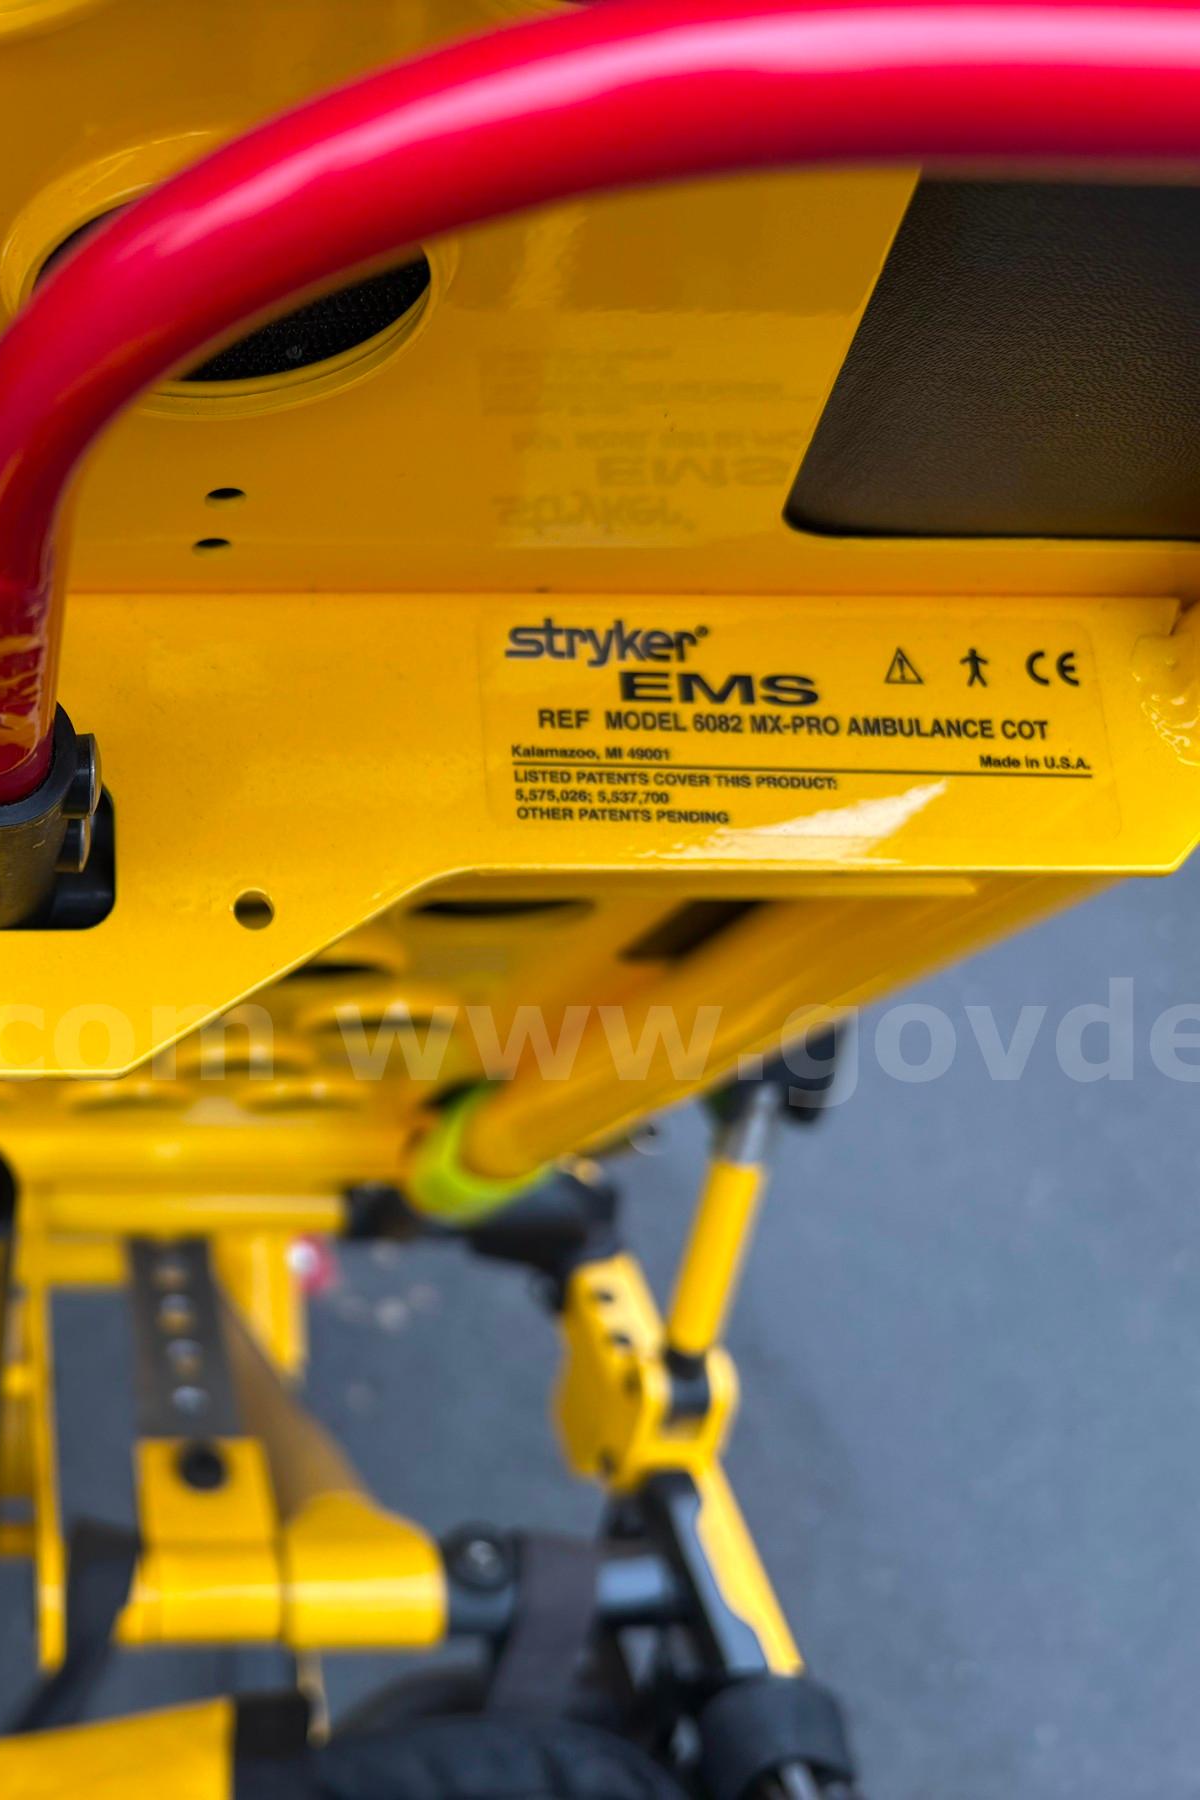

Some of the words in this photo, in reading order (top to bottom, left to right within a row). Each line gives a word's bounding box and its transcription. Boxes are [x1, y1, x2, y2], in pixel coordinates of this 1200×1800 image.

[619, 671, 819, 707] EMS
[538, 709, 589, 729] REF
[605, 711, 686, 731] MODEL
[693, 714, 743, 733] 6082
[750, 715, 840, 736] MX-PRO
[847, 717, 994, 738] AMBULANCE
[1001, 720, 1048, 740] COT
[511, 745, 600, 760] Kalamazoo,
[605, 747, 622, 759] MI
[627, 747, 670, 760] 49001
[979, 755, 1020, 768] Made
[1025, 756, 1039, 768] in
[1043, 757, 1091, 770] U.S.A.
[514, 770, 571, 783] LISTED
[576, 771, 648, 785] PATENTS
[653, 773, 709, 786] COVER
[716, 775, 751, 788] THIS
[756, 775, 837, 790] PRODUCT:
[517, 807, 573, 820] OTHER
[579, 809, 651, 823] PATENTS
[656, 810, 729, 824] PENDING
